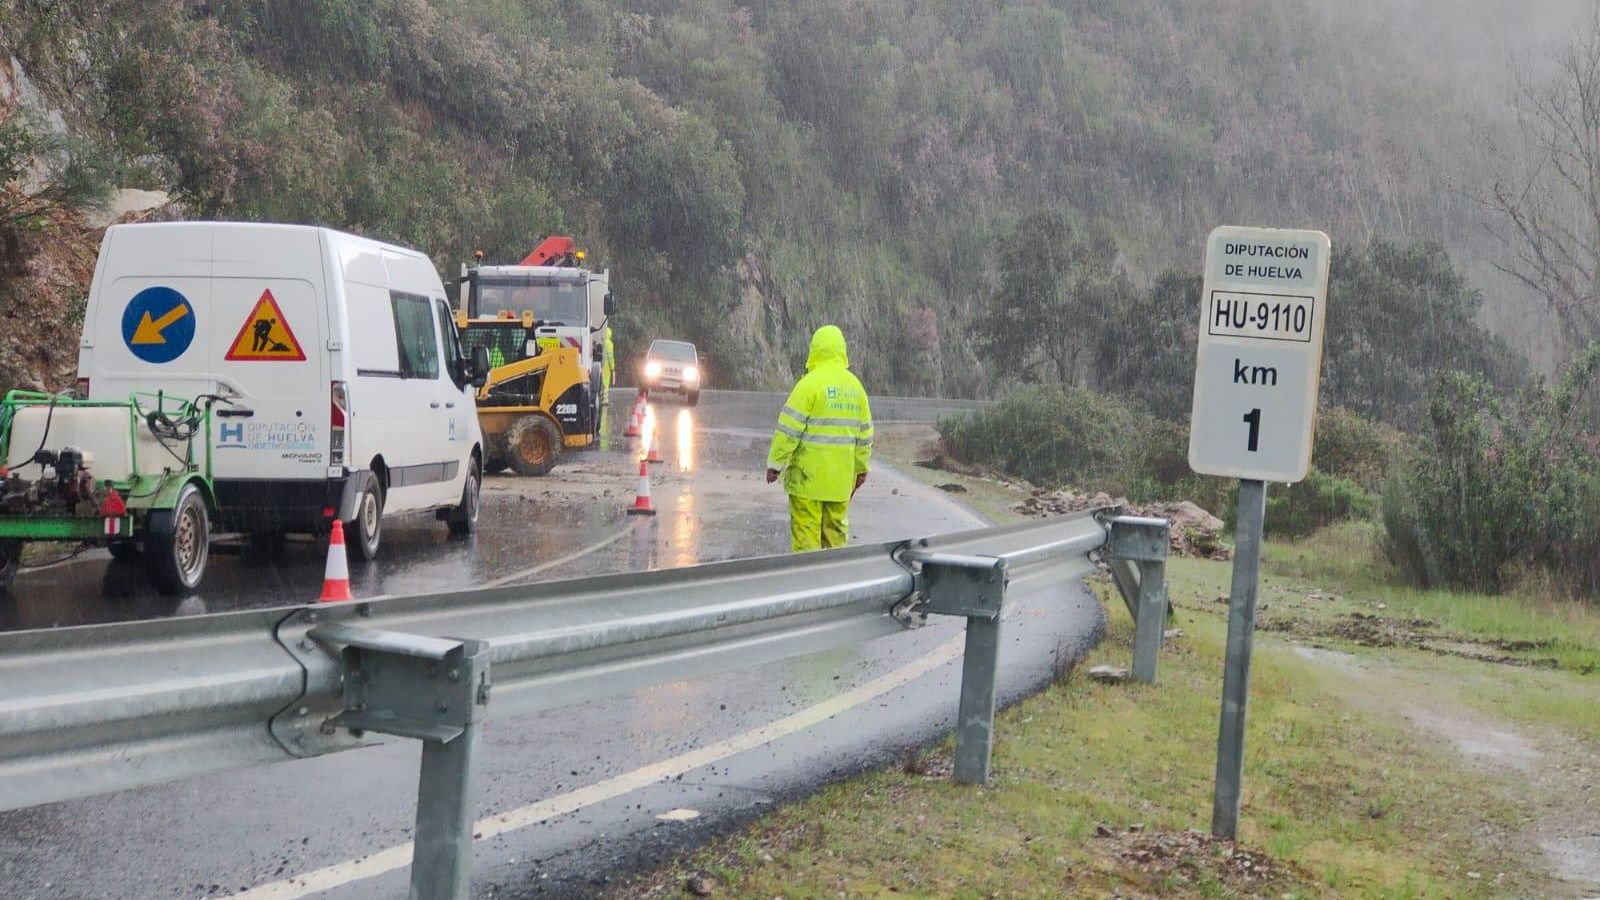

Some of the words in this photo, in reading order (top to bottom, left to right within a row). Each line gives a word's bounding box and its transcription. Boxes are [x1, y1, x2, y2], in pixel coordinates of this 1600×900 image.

[1225, 243, 1309, 259] DIPUTACIÓN
[1225, 264, 1244, 276] DE
[1248, 265, 1303, 279] HUELVA
[1215, 299, 1306, 333] HU-9110
[1233, 358, 1278, 386] km
[267, 433, 315, 442] HUELVA
[1243, 408, 1261, 452] 1
